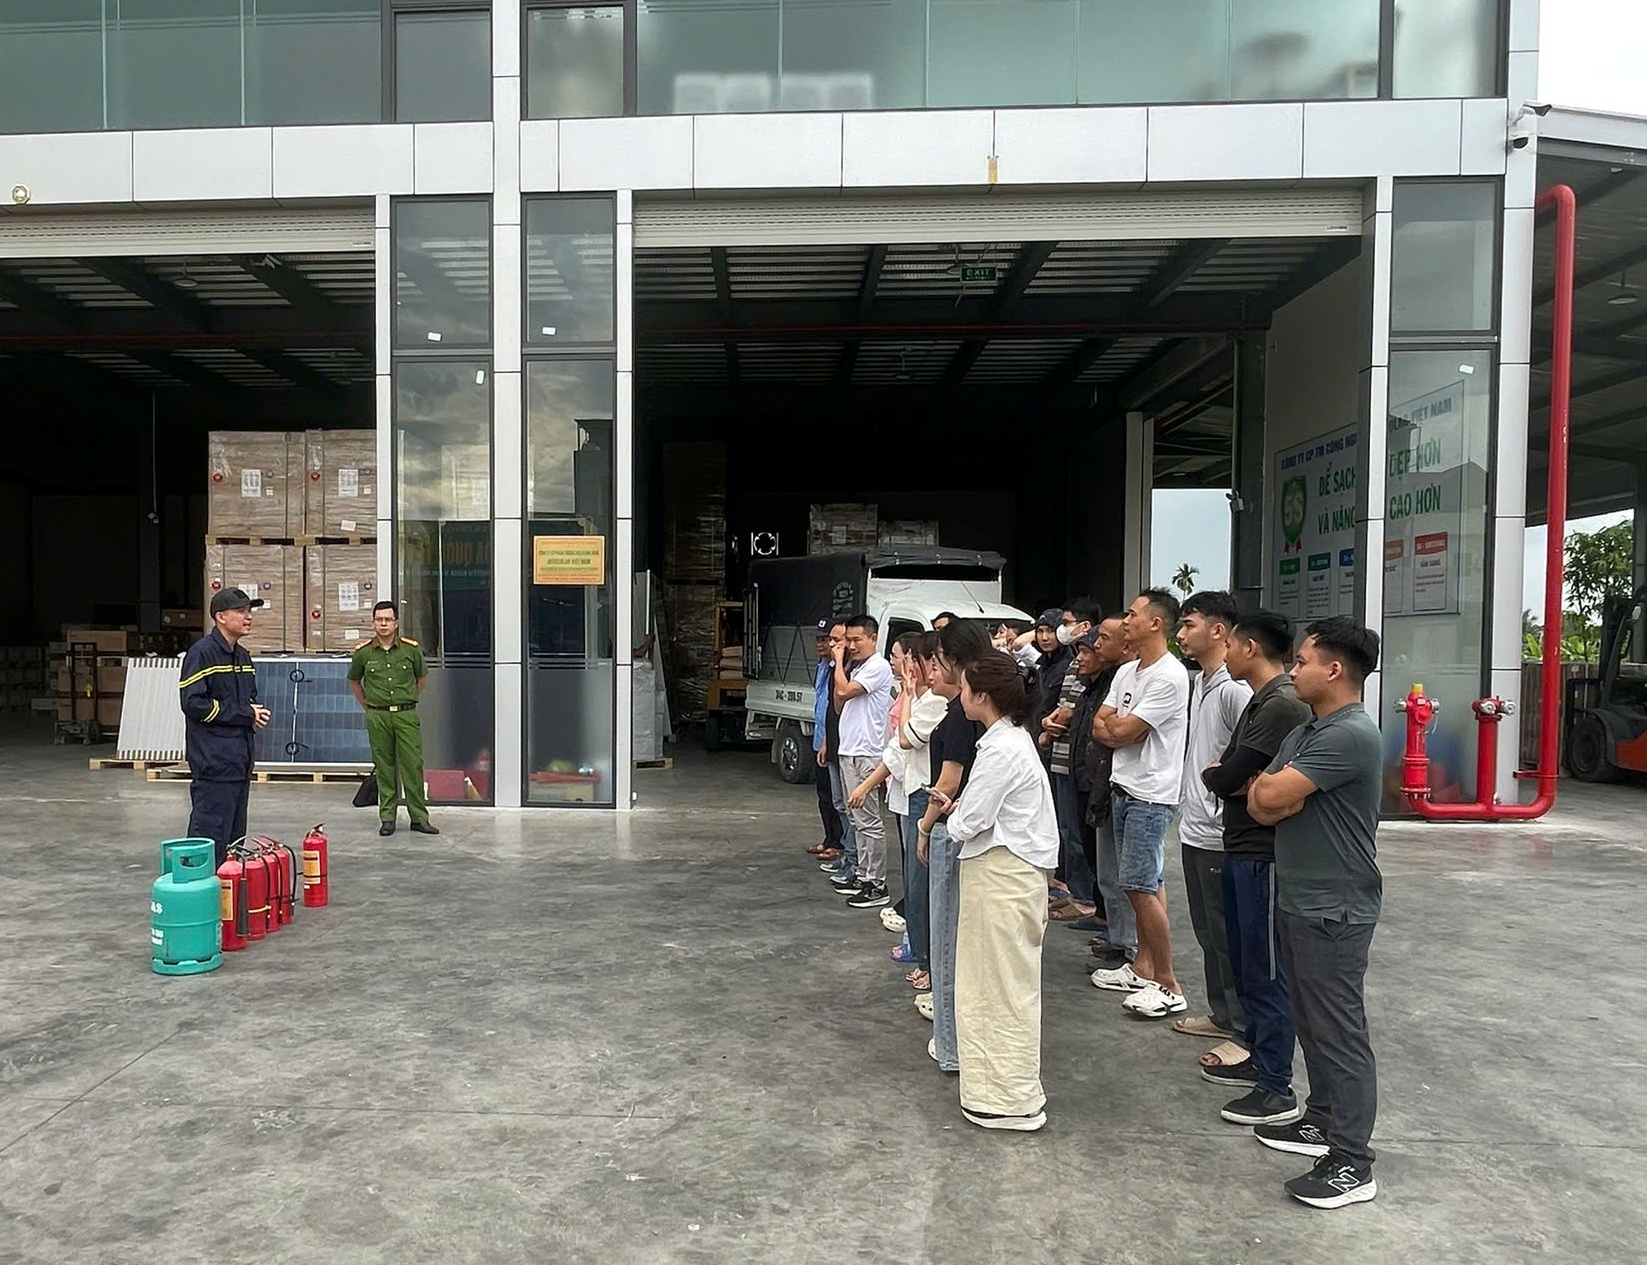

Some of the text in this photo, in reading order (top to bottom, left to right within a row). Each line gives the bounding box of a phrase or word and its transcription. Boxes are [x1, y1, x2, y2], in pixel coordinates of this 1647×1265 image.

[1430, 398, 1452, 418] NAM
[1389, 482, 1441, 521] CAO HƠN
